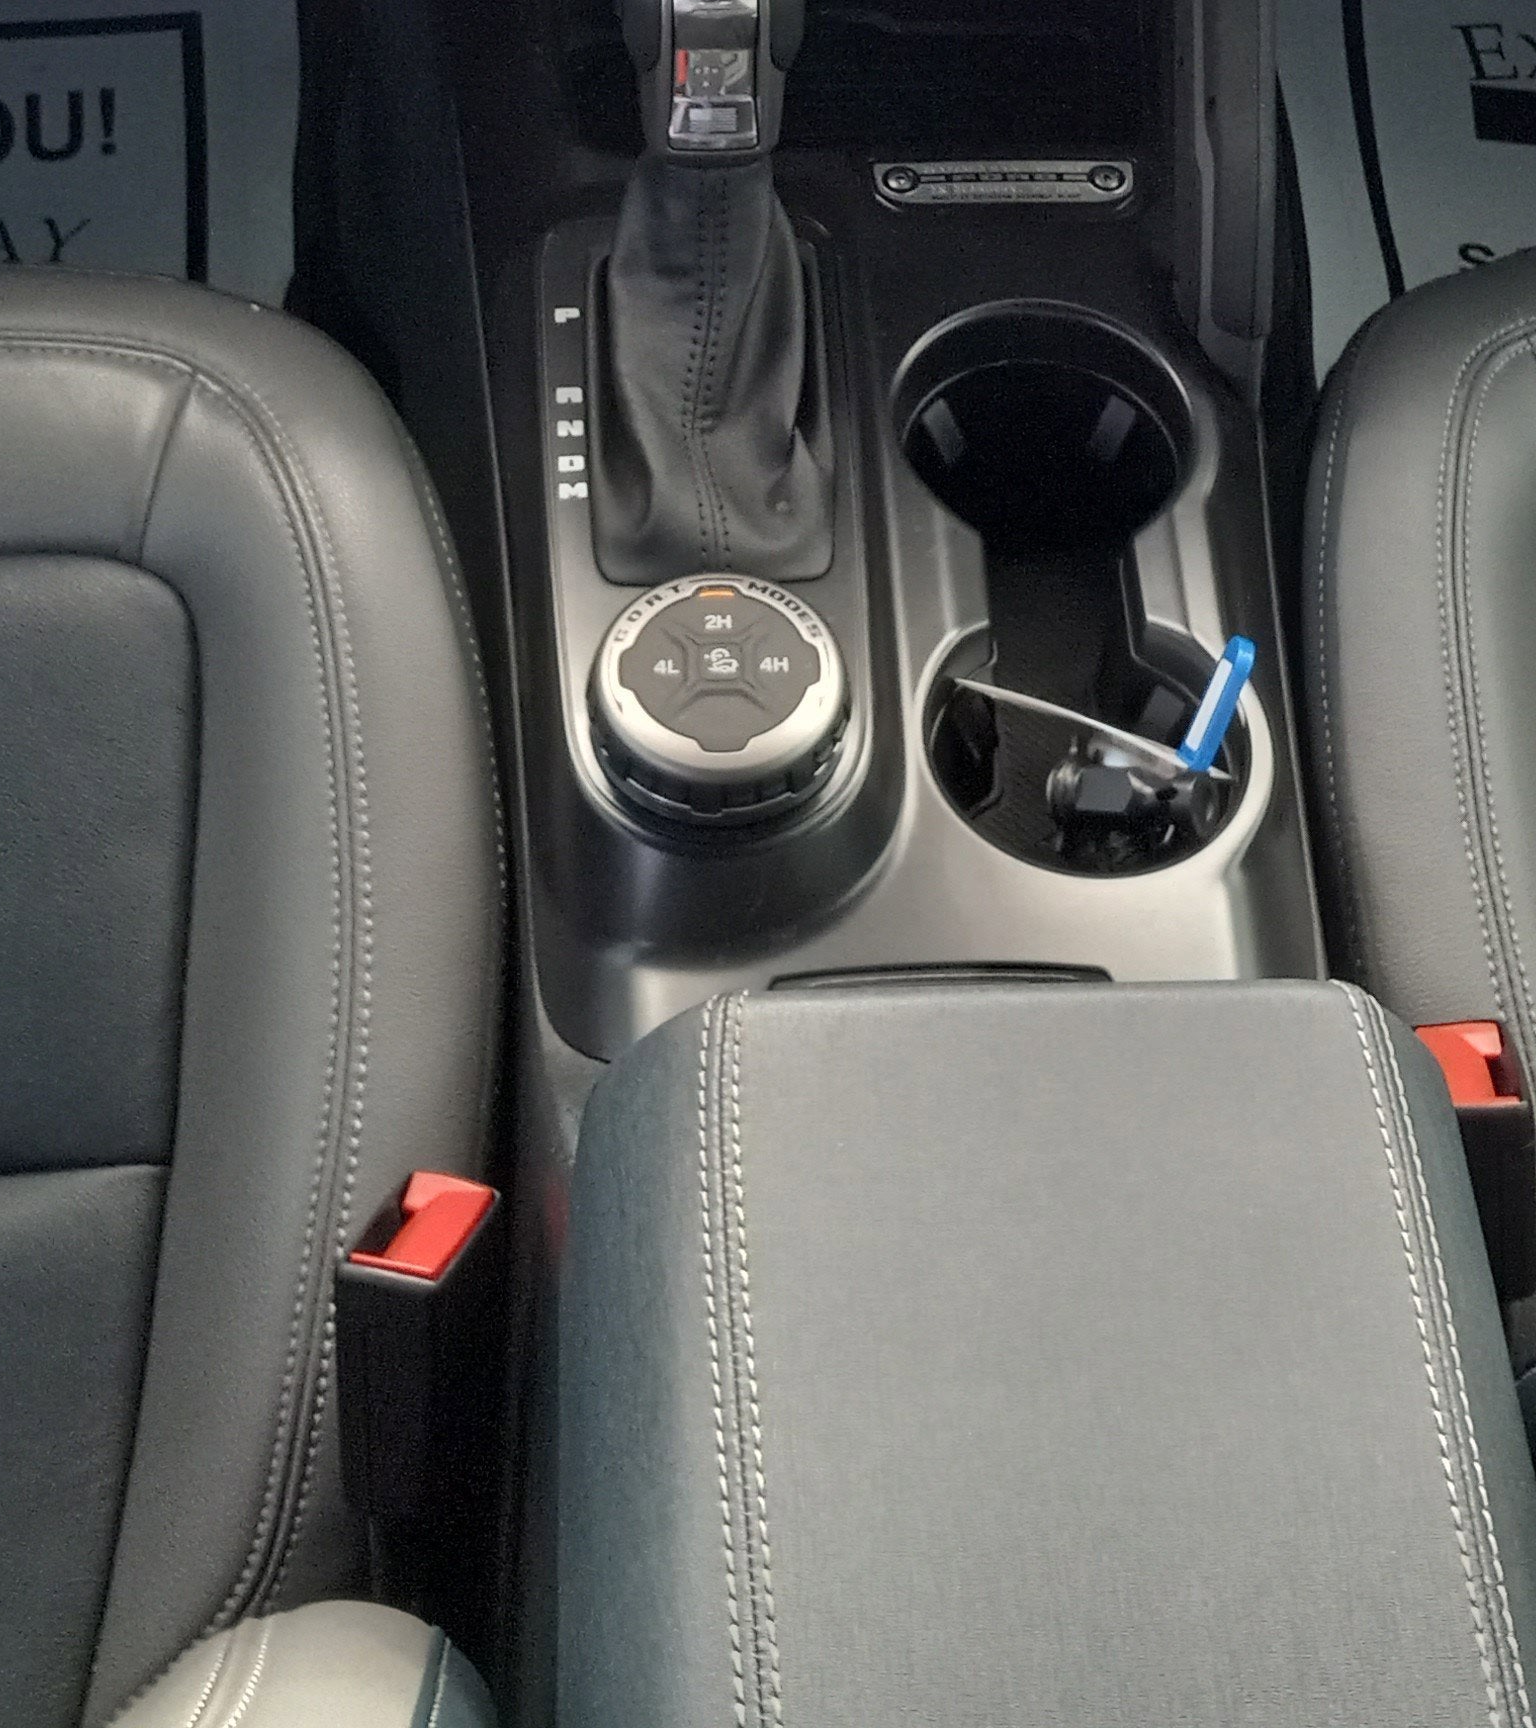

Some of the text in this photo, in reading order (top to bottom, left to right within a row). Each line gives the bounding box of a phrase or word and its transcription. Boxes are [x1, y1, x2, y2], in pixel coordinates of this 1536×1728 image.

[554, 307, 581, 324] P
[555, 386, 584, 404] R
[557, 419, 585, 438] N
[557, 455, 586, 472] D
[559, 482, 588, 501] M
[748, 581, 823, 638] MODES
[703, 614, 733, 630] 2H
[653, 659, 681, 674] 4L
[759, 657, 790, 673] 4H
